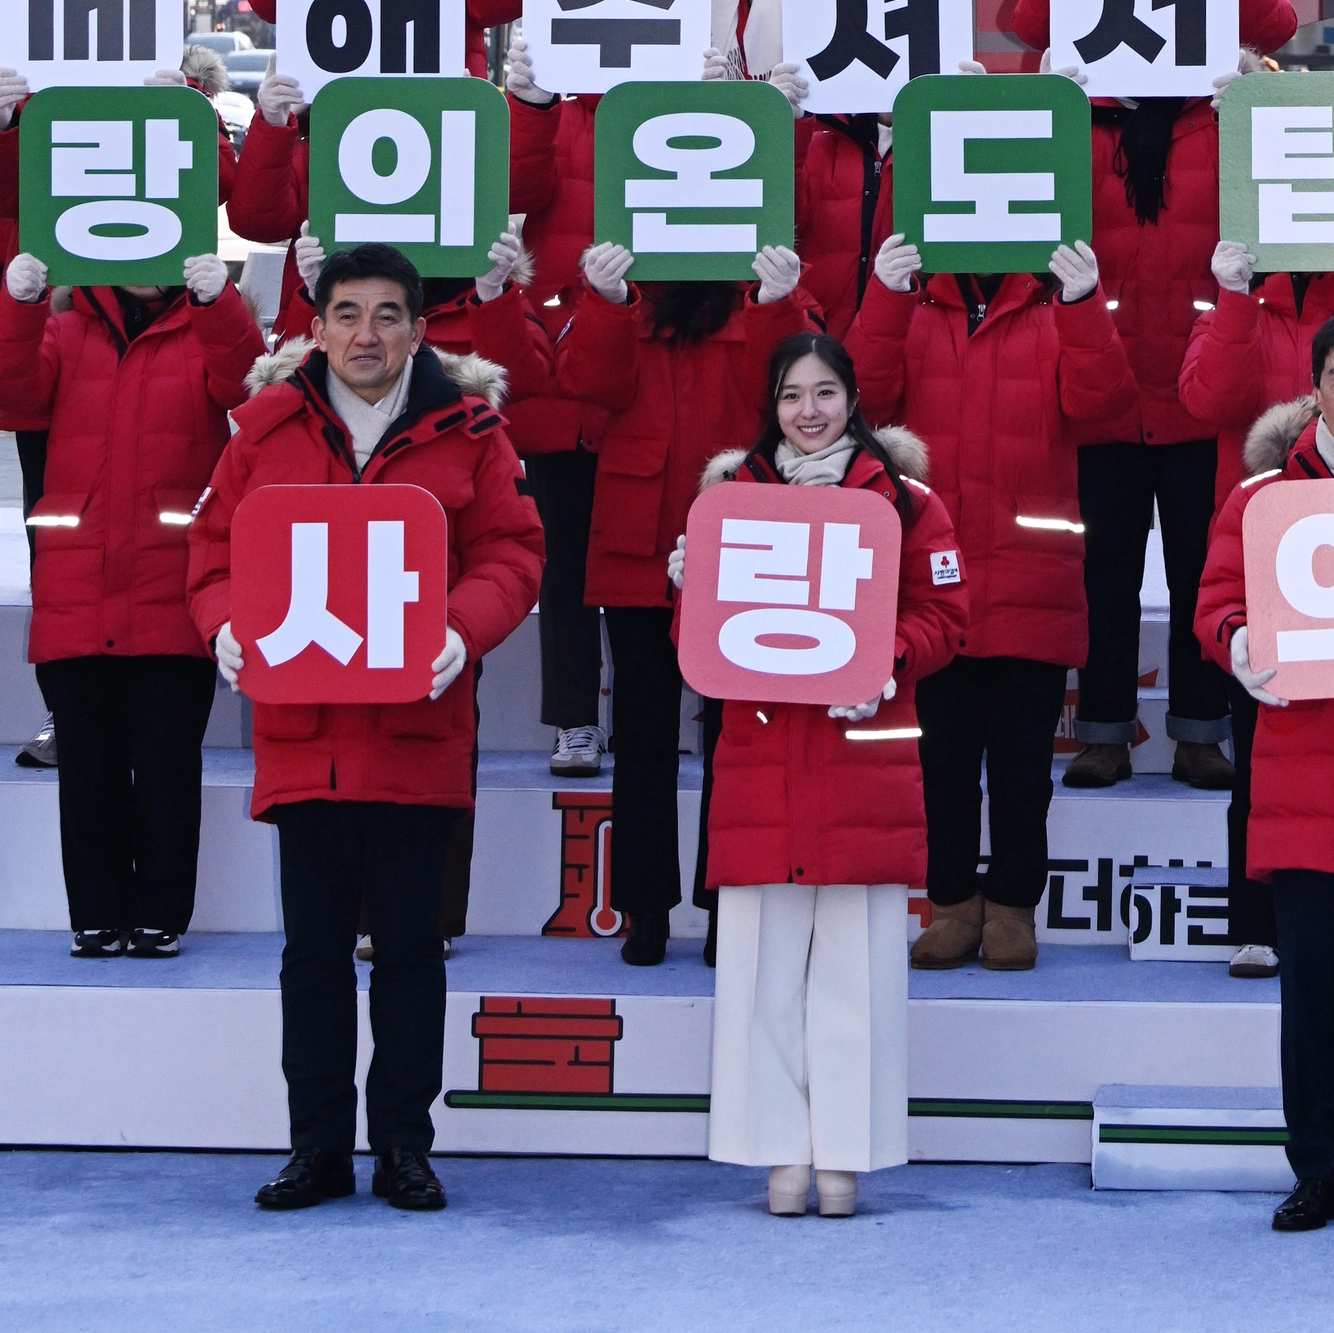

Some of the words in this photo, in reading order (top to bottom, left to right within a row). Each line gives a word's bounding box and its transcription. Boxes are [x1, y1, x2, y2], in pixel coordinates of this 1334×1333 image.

[51, 119, 193, 261] 랑
[335, 109, 476, 247] 의
[625, 112, 763, 253] 온
[924, 110, 1061, 243] 도
[255, 521, 419, 668] 사
[716, 518, 874, 675] 랑
